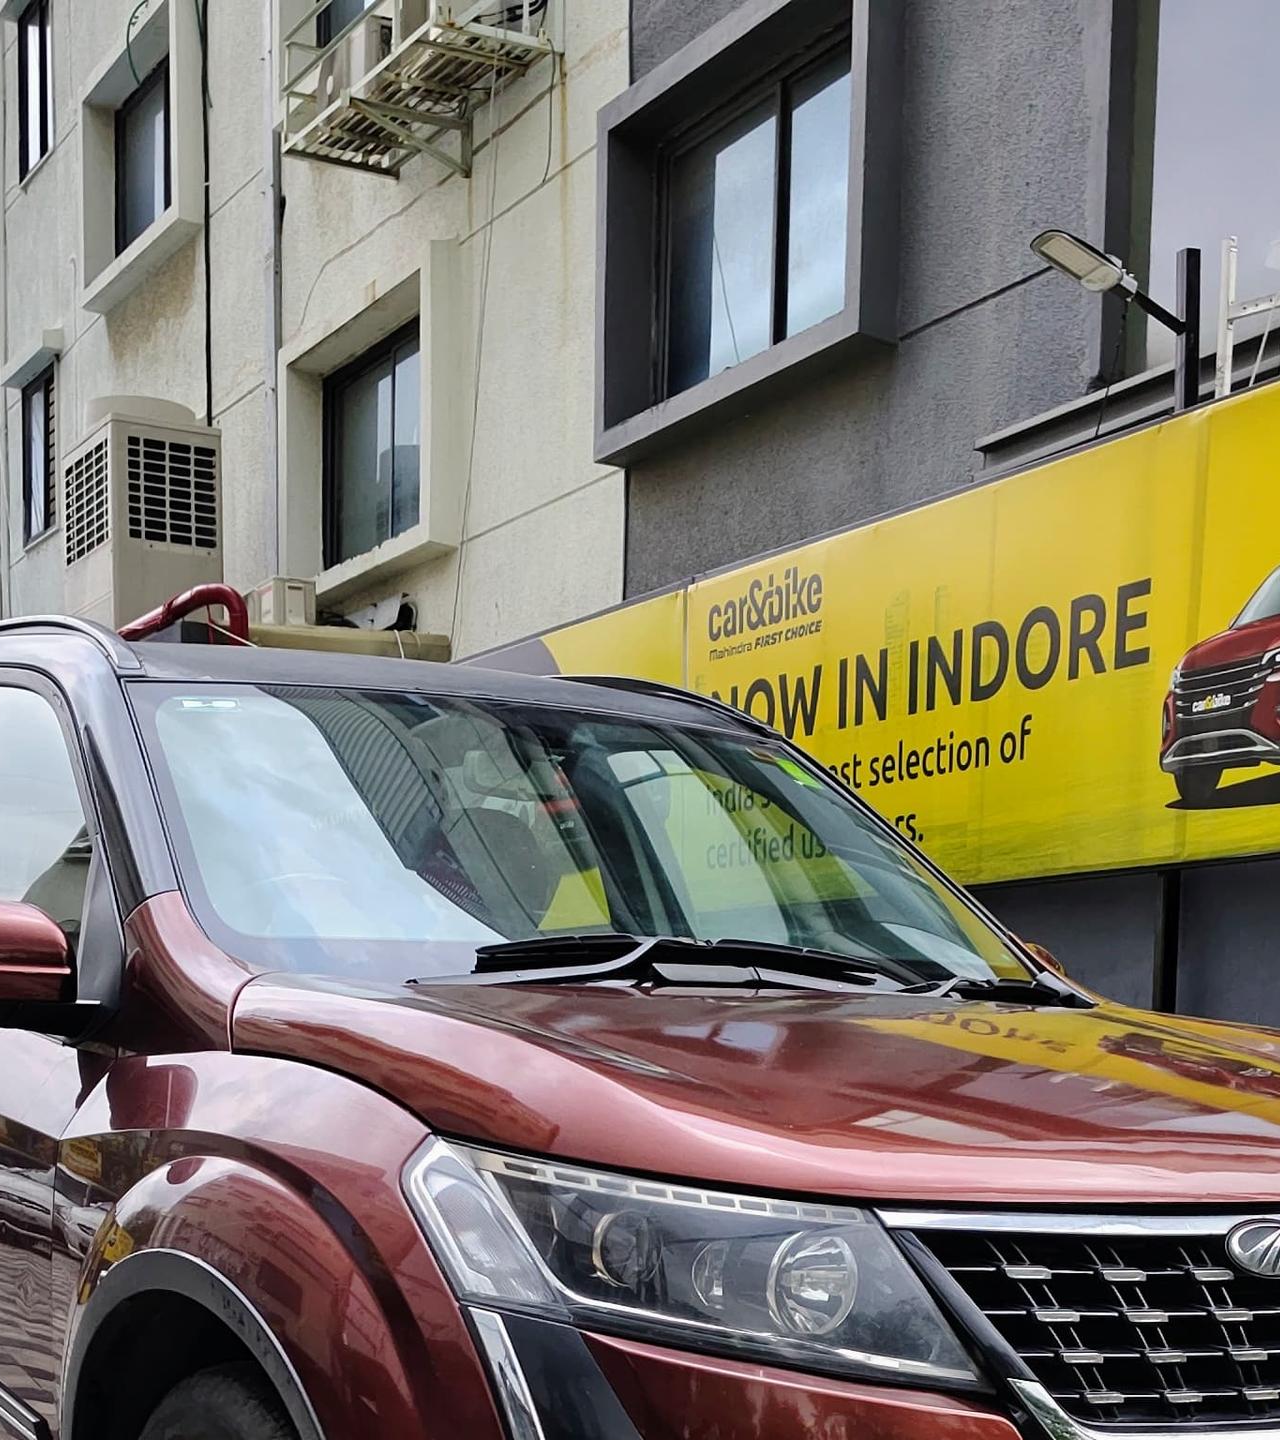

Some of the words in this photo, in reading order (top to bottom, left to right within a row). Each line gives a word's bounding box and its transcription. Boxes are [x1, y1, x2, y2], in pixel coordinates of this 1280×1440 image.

[708, 566, 822, 641] car&bike
[709, 642, 752, 661] Mahindra
[754, 631, 783, 650] FIRST
[784, 620, 822, 641] CHOICE
[838, 648, 888, 729] IN
[907, 577, 1152, 715] INDORE
[869, 731, 990, 787] selection
[999, 714, 1032, 764] of
